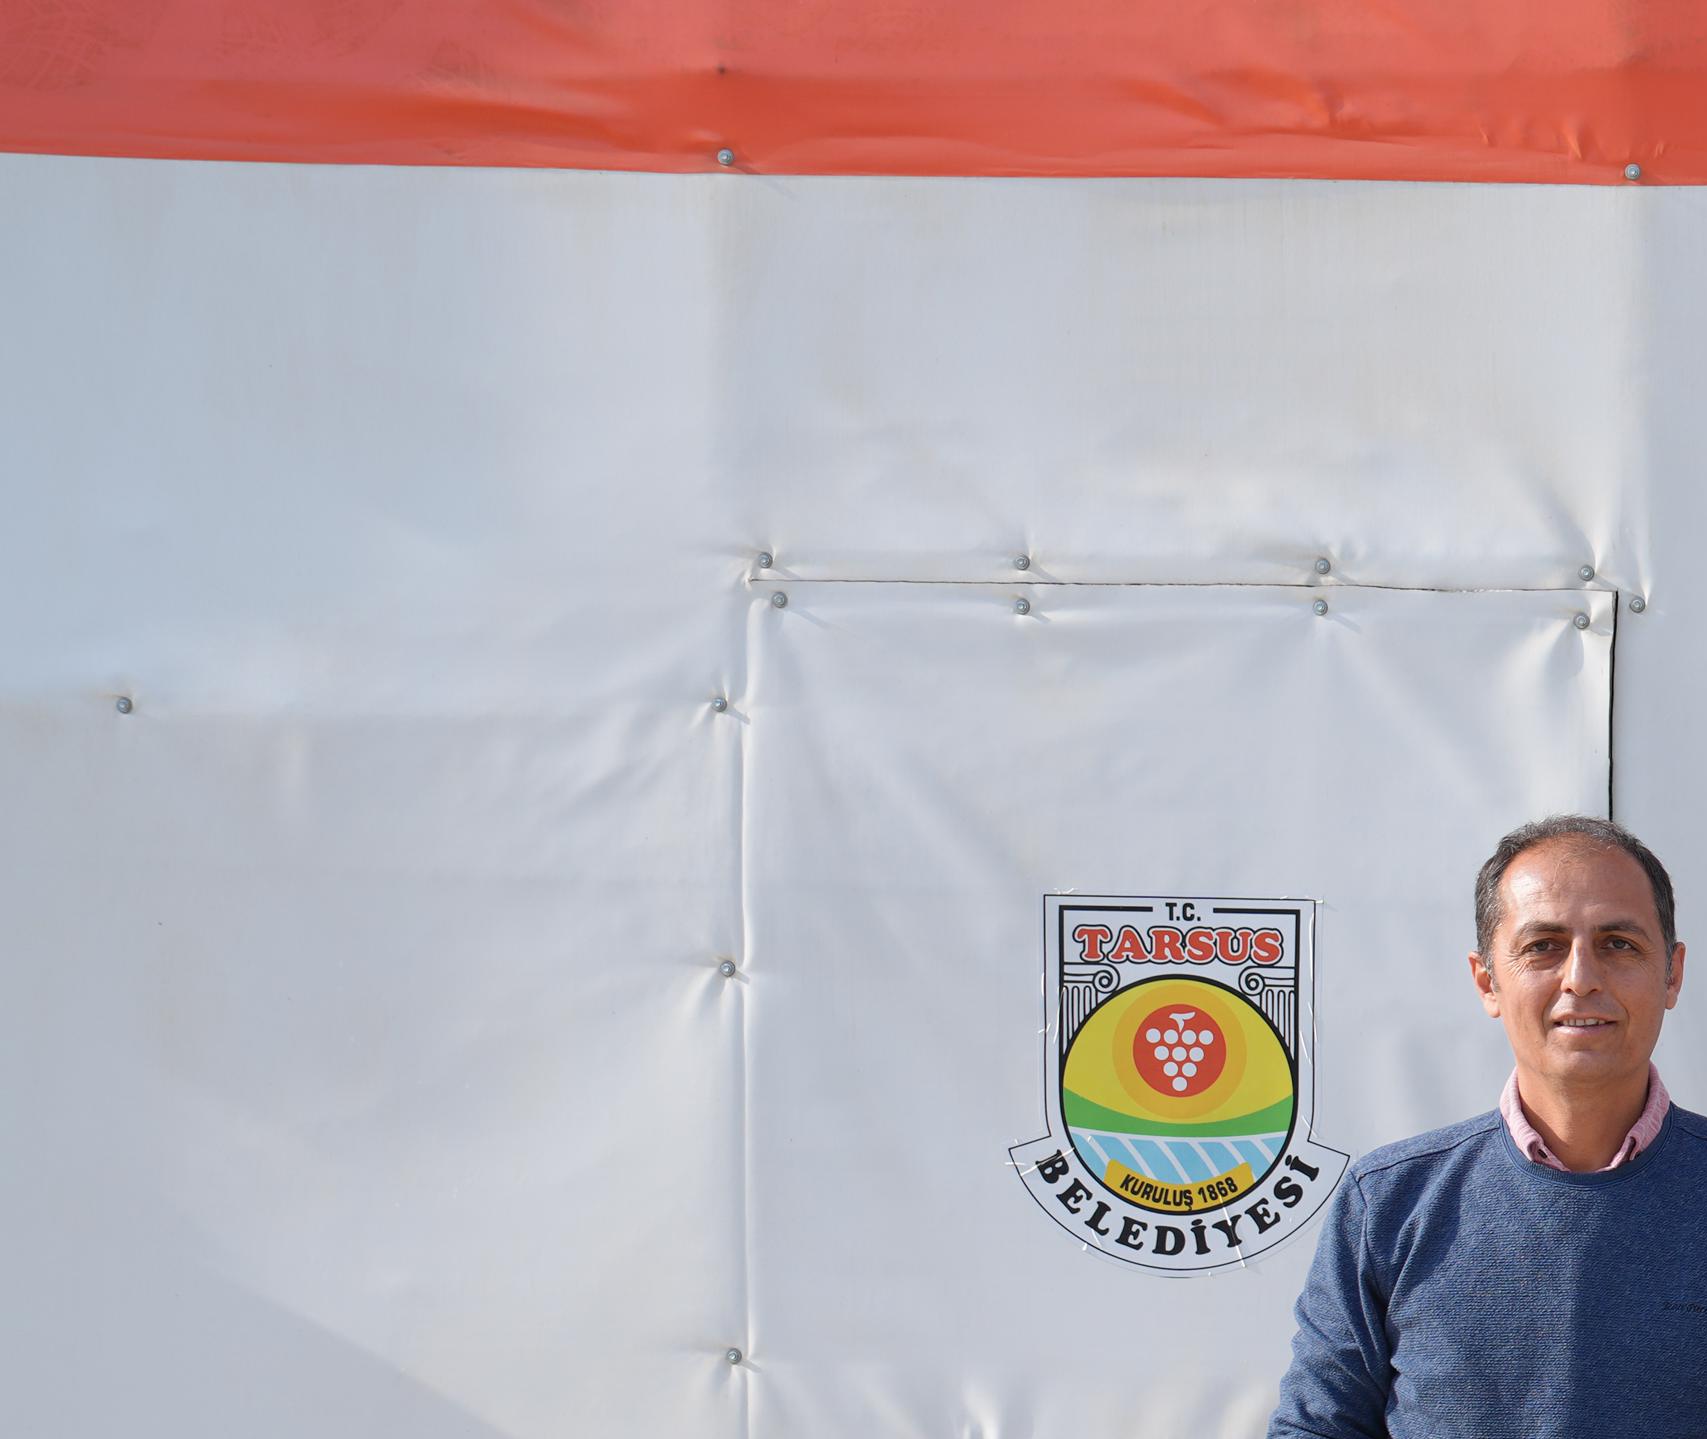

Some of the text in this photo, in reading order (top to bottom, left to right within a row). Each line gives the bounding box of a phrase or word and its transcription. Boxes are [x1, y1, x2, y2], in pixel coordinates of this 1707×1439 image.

[1165, 902, 1201, 922] T.C.
[1073, 923, 1284, 966] TARSUS
[1035, 1149, 1320, 1257] BELEDİYESİ
[1119, 1173, 1239, 1212] KURULUŞ 1868
